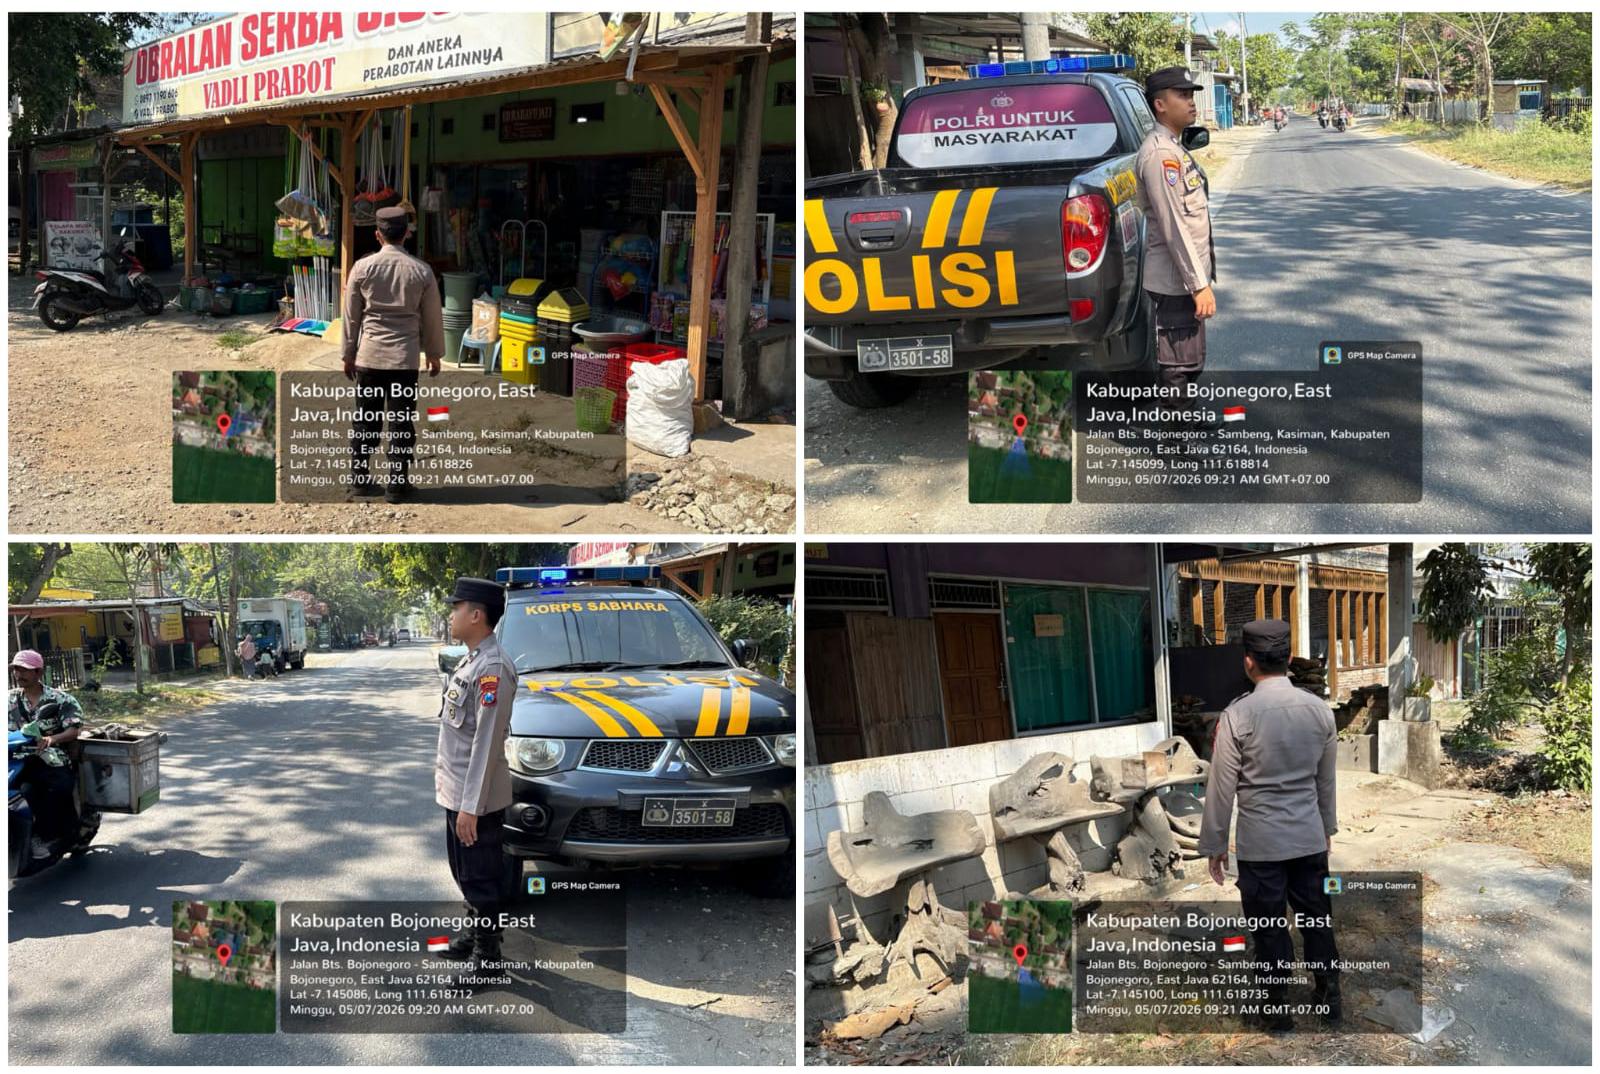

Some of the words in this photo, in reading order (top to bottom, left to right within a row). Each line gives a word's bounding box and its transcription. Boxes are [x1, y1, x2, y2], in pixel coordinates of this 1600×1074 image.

[136, 22, 232, 86] OBRALAN
[241, 12, 343, 61] SERBA
[388, 44, 413, 60] DAN
[417, 35, 462, 54] ANEKA
[363, 59, 434, 82] PERABOTAN
[438, 46, 504, 70] LAINNYA
[204, 75, 248, 110] VADLI
[254, 57, 336, 101] PRABOT
[934, 114, 995, 131] POLRI
[1002, 110, 1076, 126] UNTUK
[934, 128, 1078, 148] MASYARAKAT
[892, 350, 950, 367] 3501-58
[525, 602, 582, 615] KORPS
[587, 601, 669, 613] SABHARA
[526, 674, 760, 692] POLISI
[675, 809, 730, 824] 3501-58
